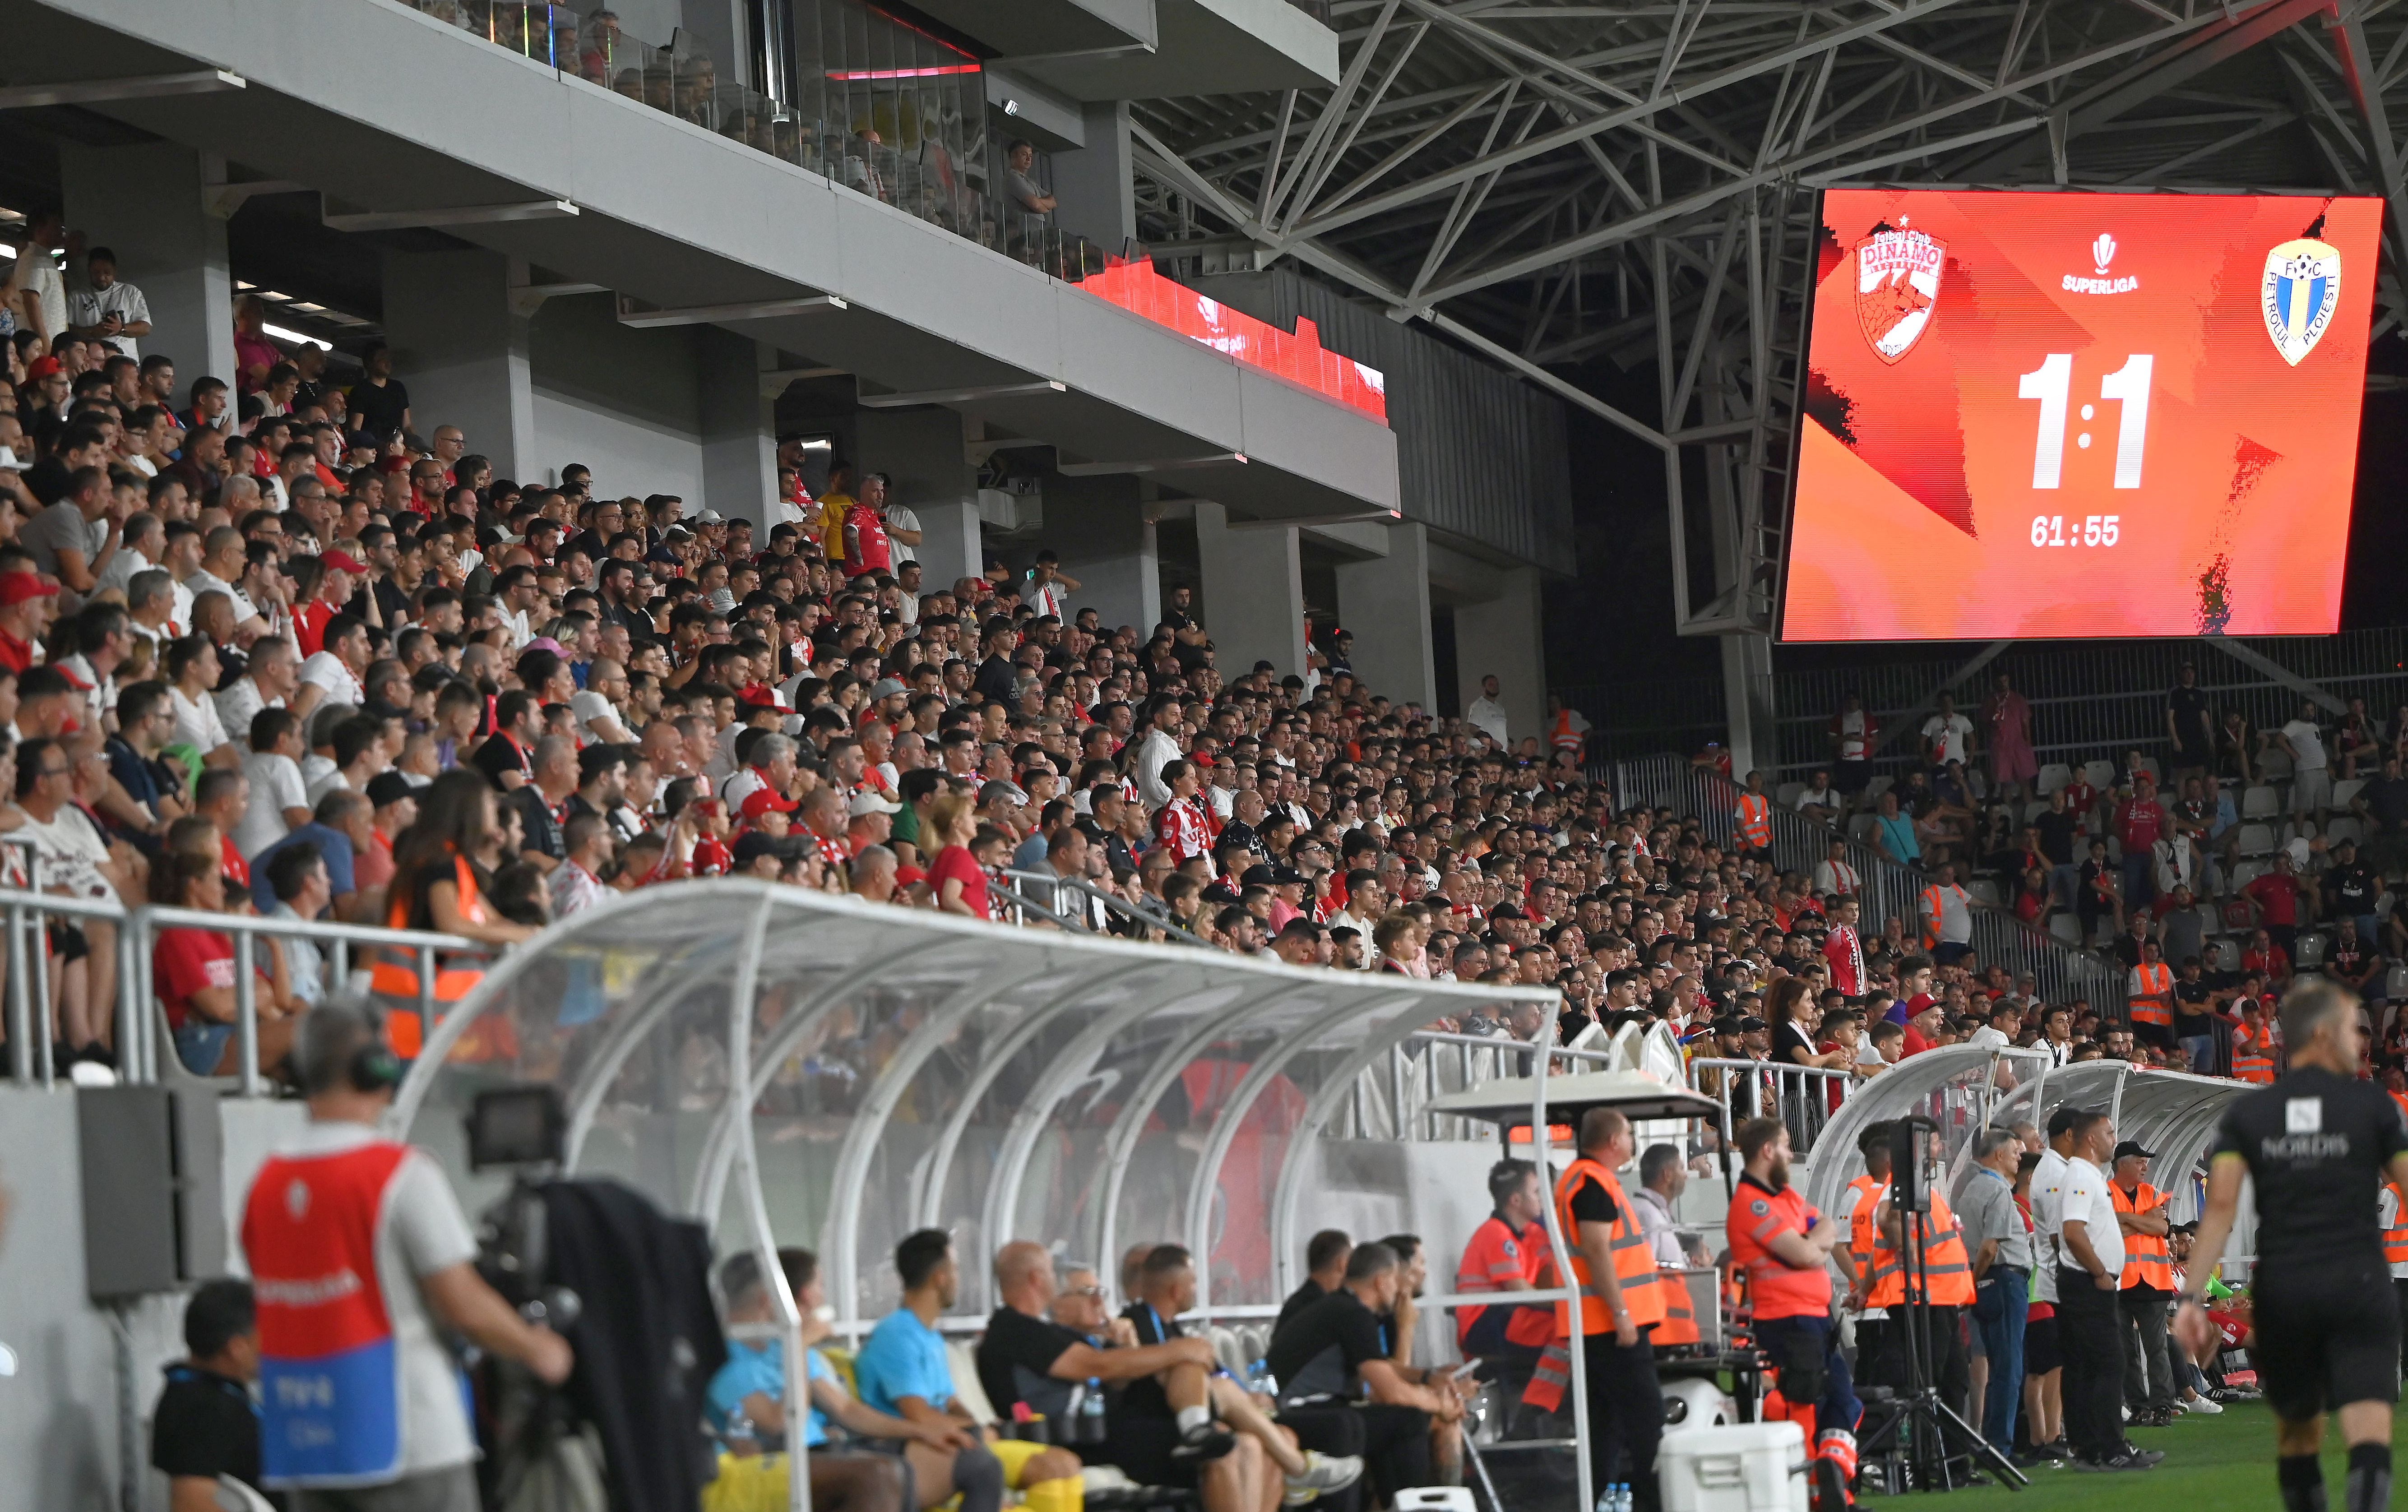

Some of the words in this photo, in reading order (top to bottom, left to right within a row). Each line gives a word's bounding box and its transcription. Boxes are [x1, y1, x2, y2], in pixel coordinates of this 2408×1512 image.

[1865, 243, 1938, 265] DINAMO
[2062, 275, 2137, 294] SUPERLIGA
[2267, 272, 2288, 349] PETROLUL
[2303, 276, 2335, 345] PLOIESTI
[2019, 354, 2153, 489] 1:1
[2031, 516, 2119, 547] 61:55
